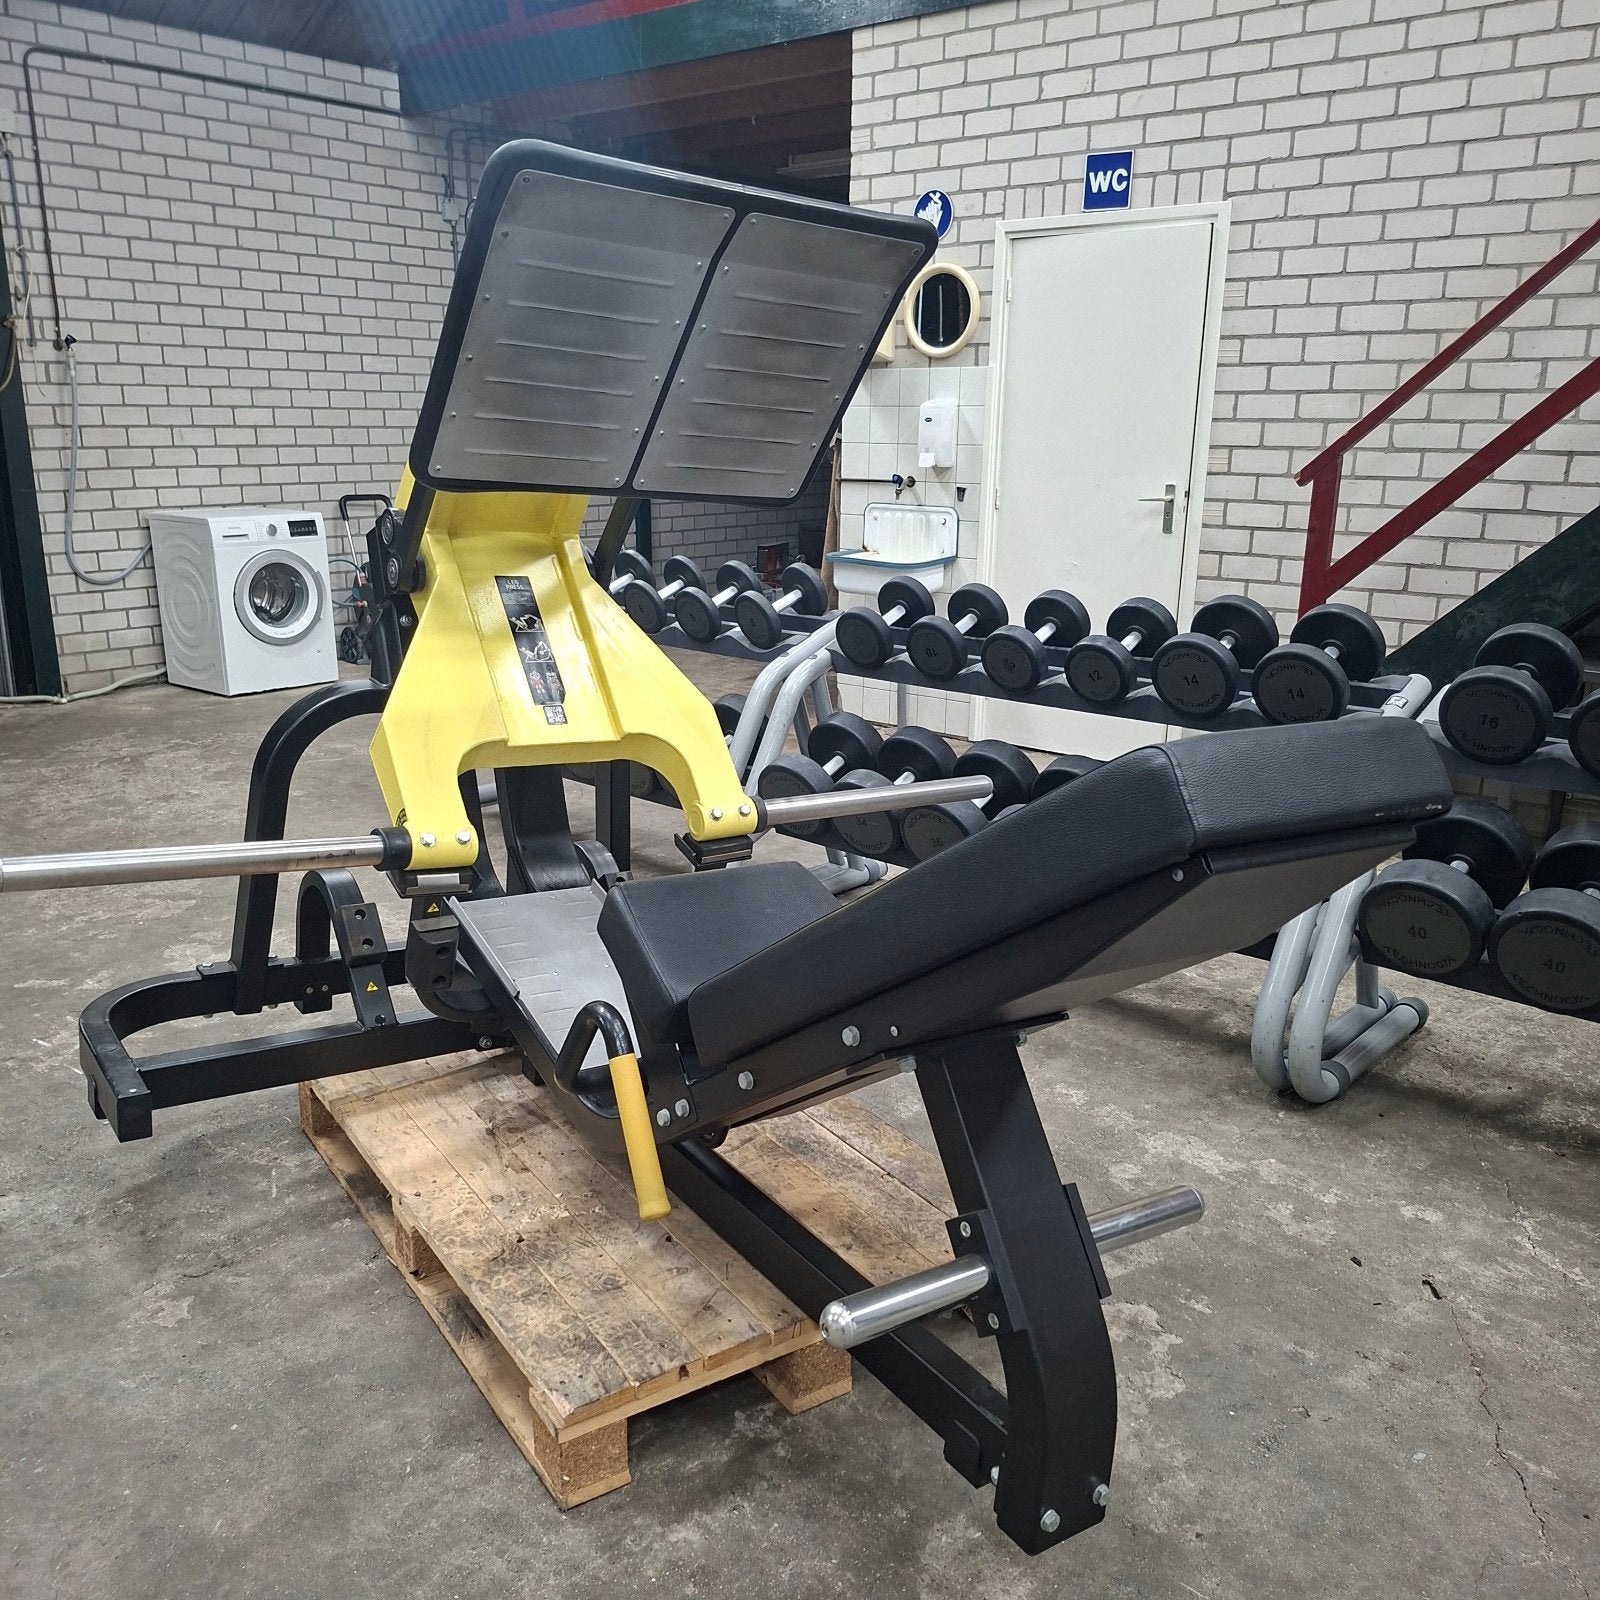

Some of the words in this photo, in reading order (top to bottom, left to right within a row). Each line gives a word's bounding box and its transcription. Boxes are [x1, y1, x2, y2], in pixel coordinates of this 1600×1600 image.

[1089, 168, 1128, 193] WC
[925, 647, 938, 658] 10
[1089, 670, 1103, 682] 12
[1183, 674, 1200, 687] 14
[1287, 687, 1306, 700] 14
[1480, 714, 1500, 729] 16
[929, 836, 944, 848] 36
[1407, 925, 1428, 940] 40
[1543, 958, 1567, 974] 40
